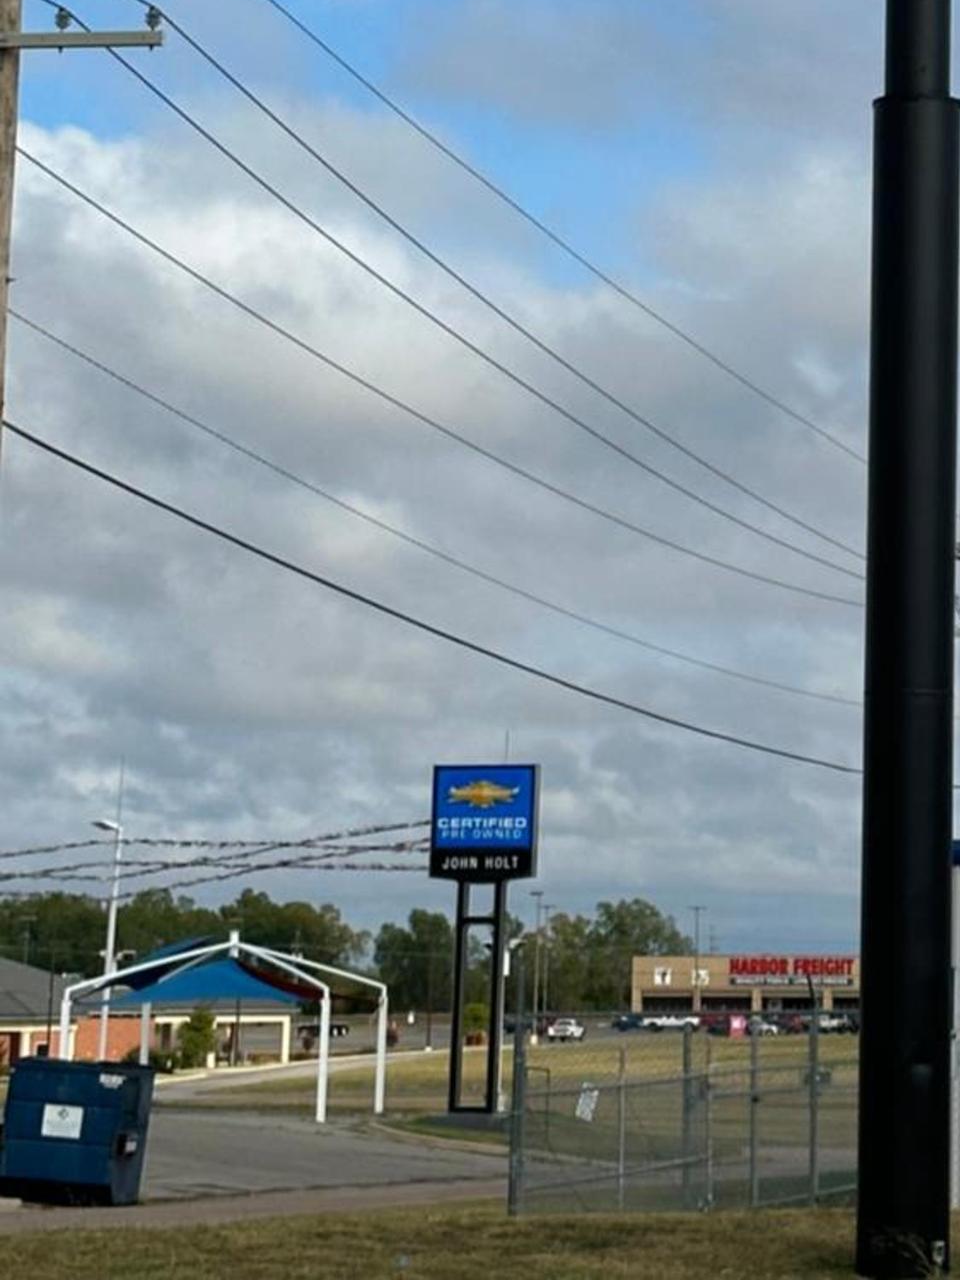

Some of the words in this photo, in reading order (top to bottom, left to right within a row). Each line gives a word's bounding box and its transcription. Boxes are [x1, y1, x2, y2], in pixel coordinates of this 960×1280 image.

[437, 817, 528, 829] CERTIFIED
[441, 856, 478, 870] JOHN
[484, 856, 519, 869] HOLT
[729, 957, 788, 975] HARBOR
[794, 957, 855, 975] FREIGHT
